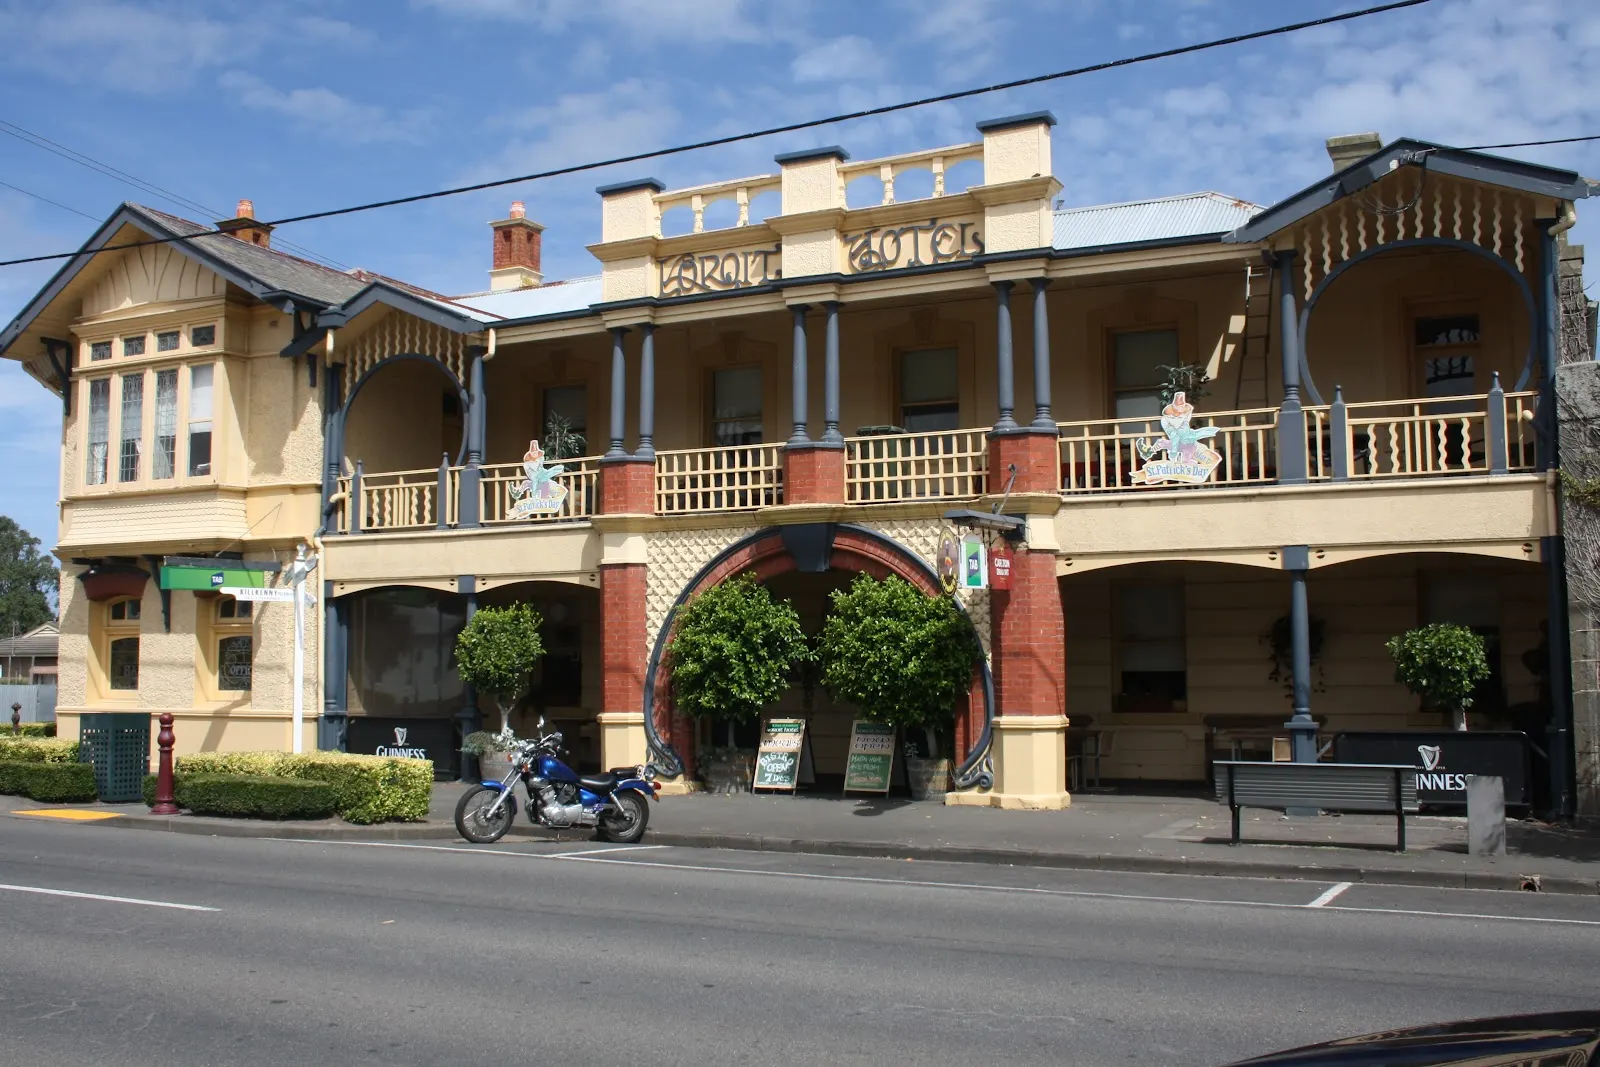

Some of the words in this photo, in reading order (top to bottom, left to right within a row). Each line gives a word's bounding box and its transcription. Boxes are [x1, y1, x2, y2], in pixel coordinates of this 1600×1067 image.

[843, 218, 985, 273] HOTEL
[1192, 466, 1209, 478] Day
[548, 501, 560, 510] Day
[968, 559, 979, 570] TAB
[994, 557, 1011, 568] CARLTON
[211, 576, 224, 584] TAB
[230, 665, 251, 677] OFFI
[376, 745, 426, 760] GUINNESS
[760, 752, 794, 767] BISTRO
[766, 763, 789, 773] OPEN
[764, 773, 773, 783] 7
[1415, 773, 1474, 791] INNES
